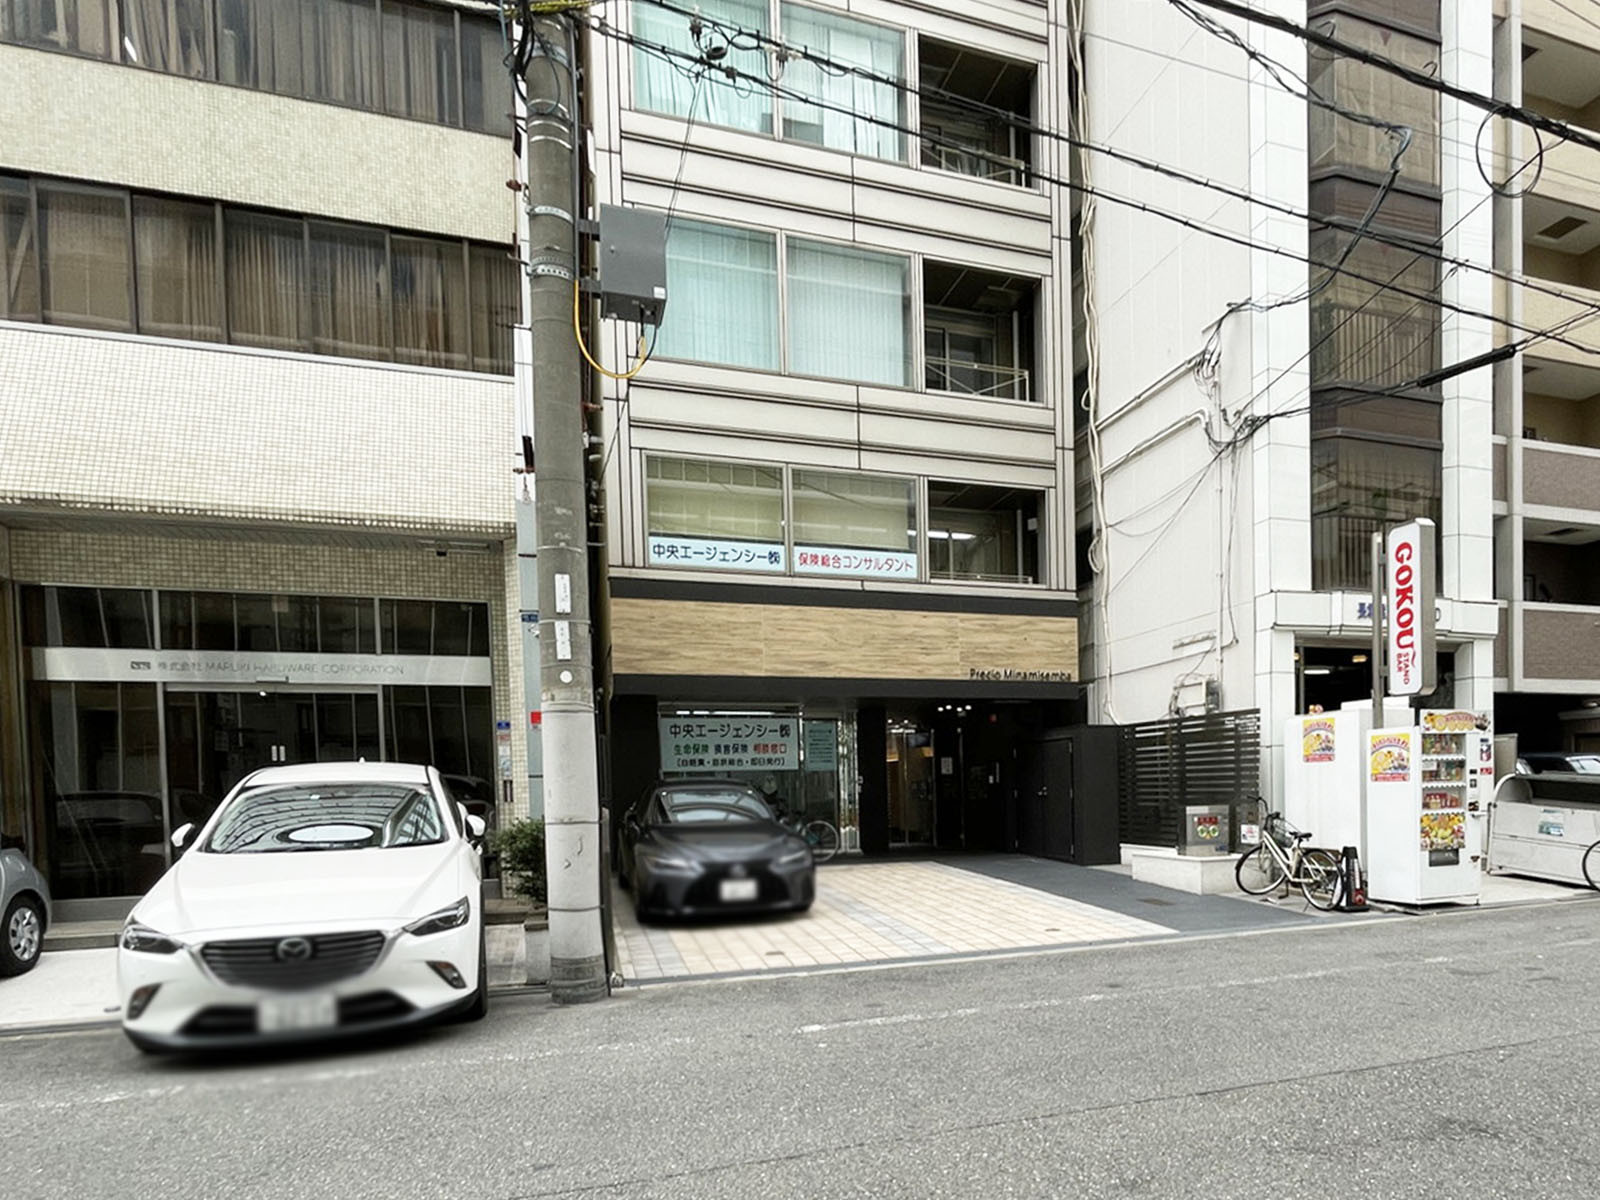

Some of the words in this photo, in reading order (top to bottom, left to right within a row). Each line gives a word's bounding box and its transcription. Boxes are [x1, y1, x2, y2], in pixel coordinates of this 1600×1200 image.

[798, 552, 913, 572] 保険総合コンサルタント
[1395, 542, 1415, 650] GOKOU
[253, 663, 317, 674] HARDWARE
[321, 663, 404, 675] CORPORATION
[970, 668, 1001, 681] Precio
[1004, 668, 1072, 681] Minamisemba
[673, 743, 710, 755] 生命保険
